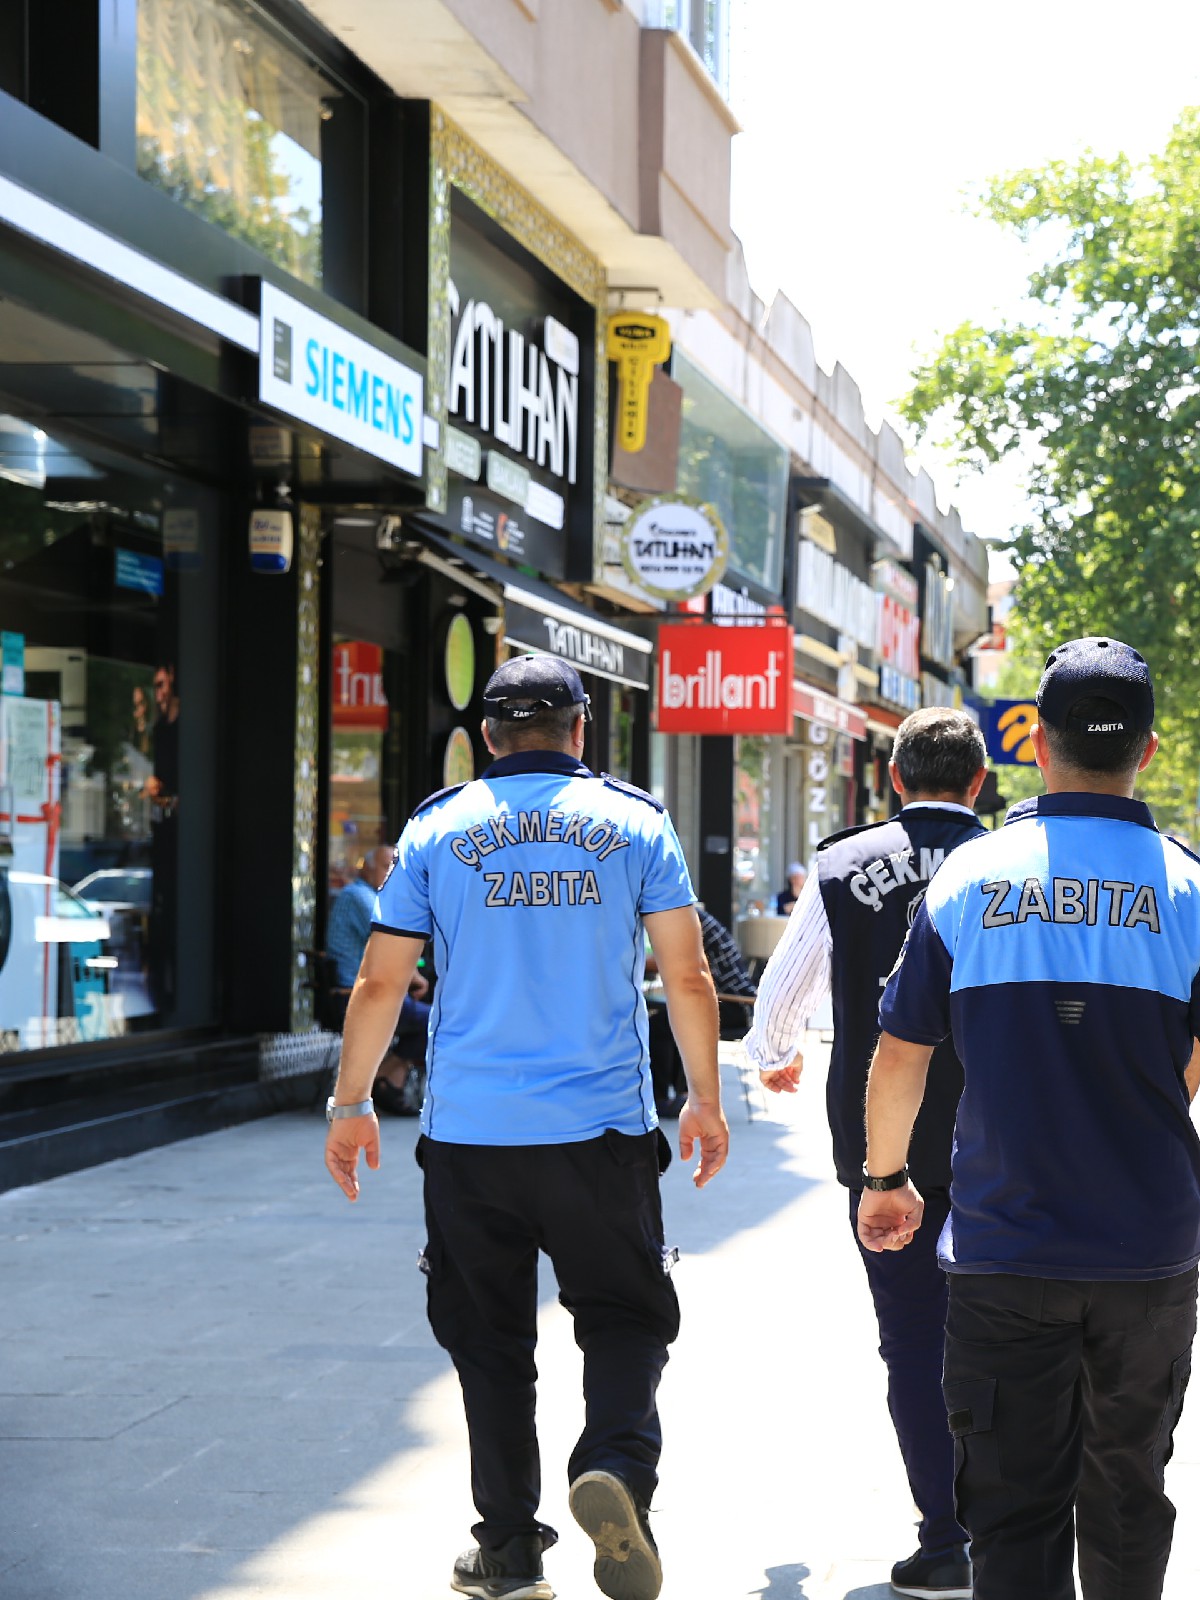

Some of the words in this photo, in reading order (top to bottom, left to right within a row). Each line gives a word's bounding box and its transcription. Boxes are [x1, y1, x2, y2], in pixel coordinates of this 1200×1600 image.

[305, 338, 414, 445] SIEMENS
[662, 649, 781, 709] brillant
[1087, 722, 1124, 732] ZABITA
[808, 722, 829, 874] GÖZL
[451, 810, 630, 872] ÇEKMEKÖY
[484, 870, 602, 907] ZABITA
[981, 877, 1161, 934] ZABITA
